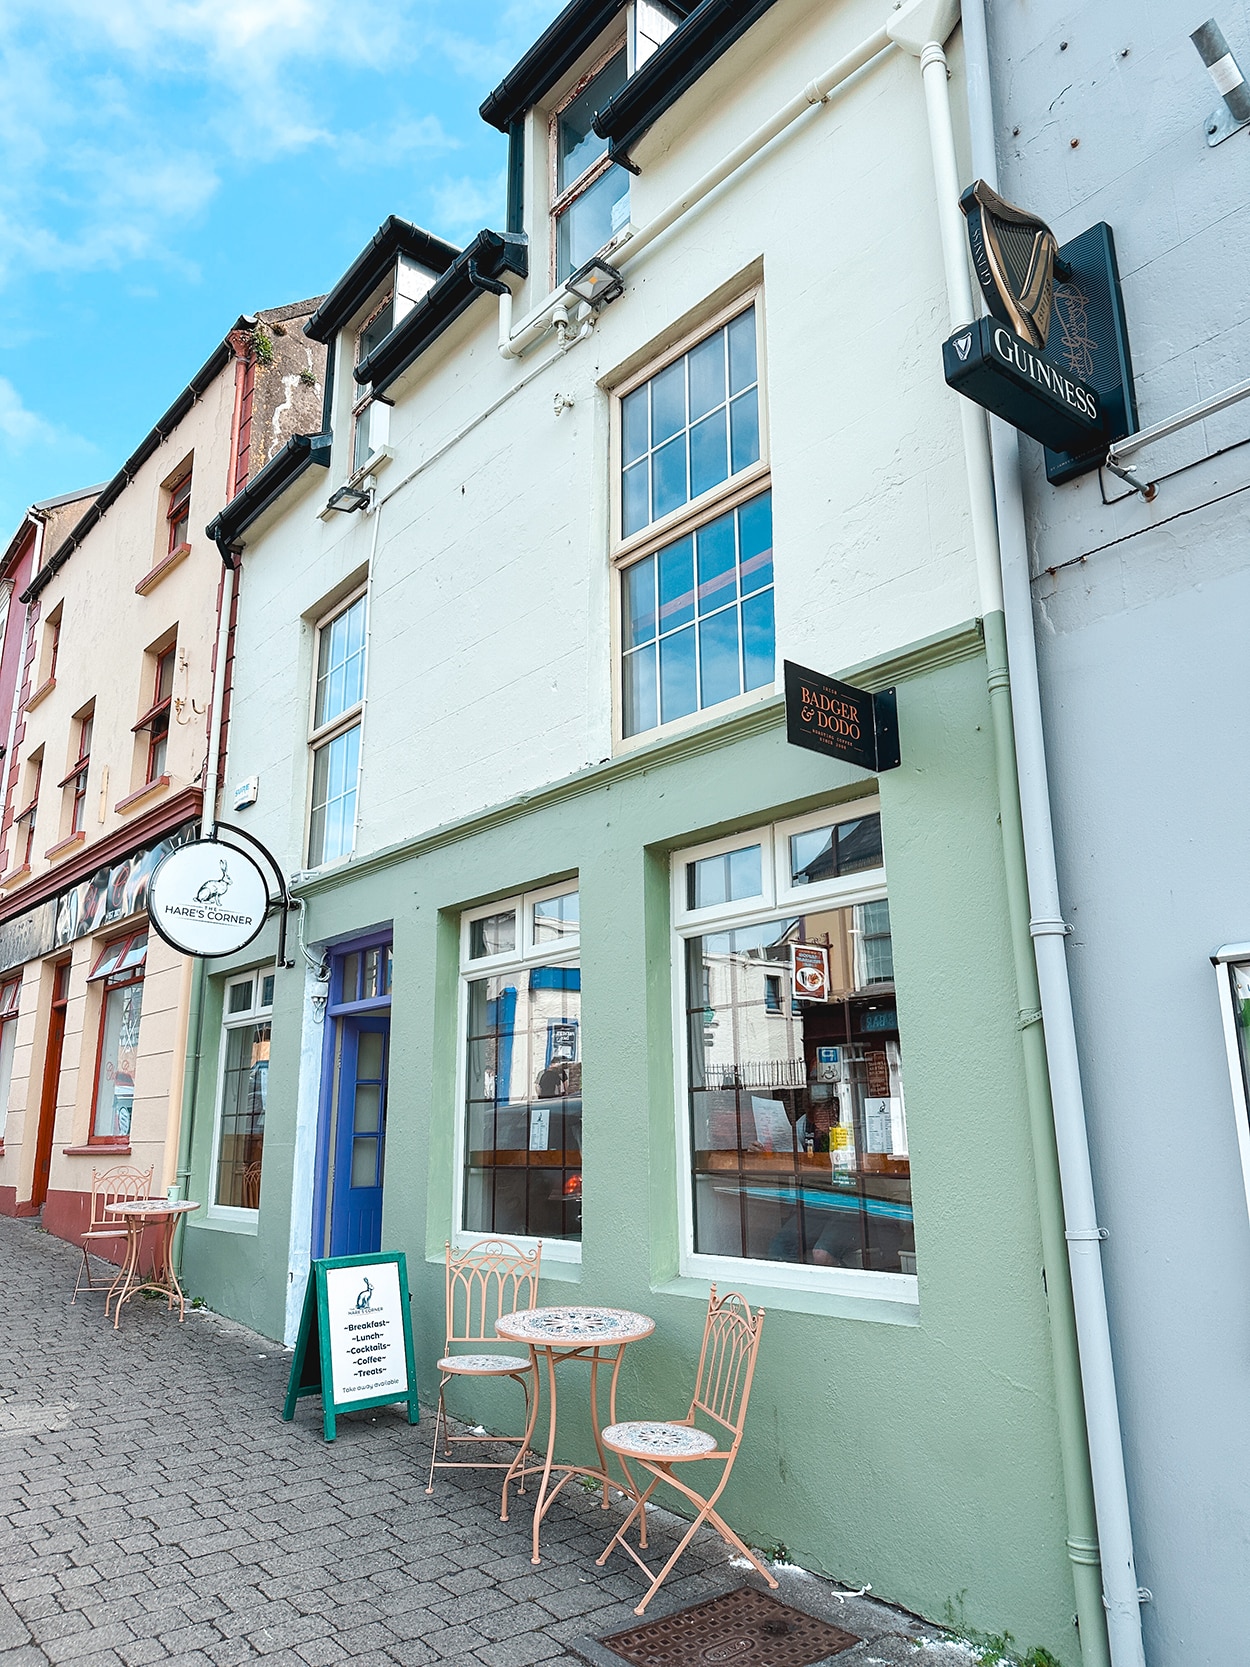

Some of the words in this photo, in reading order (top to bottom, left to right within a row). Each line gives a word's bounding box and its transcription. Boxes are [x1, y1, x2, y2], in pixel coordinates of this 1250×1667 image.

[994, 328, 1097, 419] GUINNESS
[801, 686, 860, 724] BADGER
[801, 705, 815, 722] &
[817, 710, 861, 740] DODO
[165, 905, 205, 919] HARE'S
[207, 911, 253, 926] CORNER
[373, 1379, 400, 1388] available
